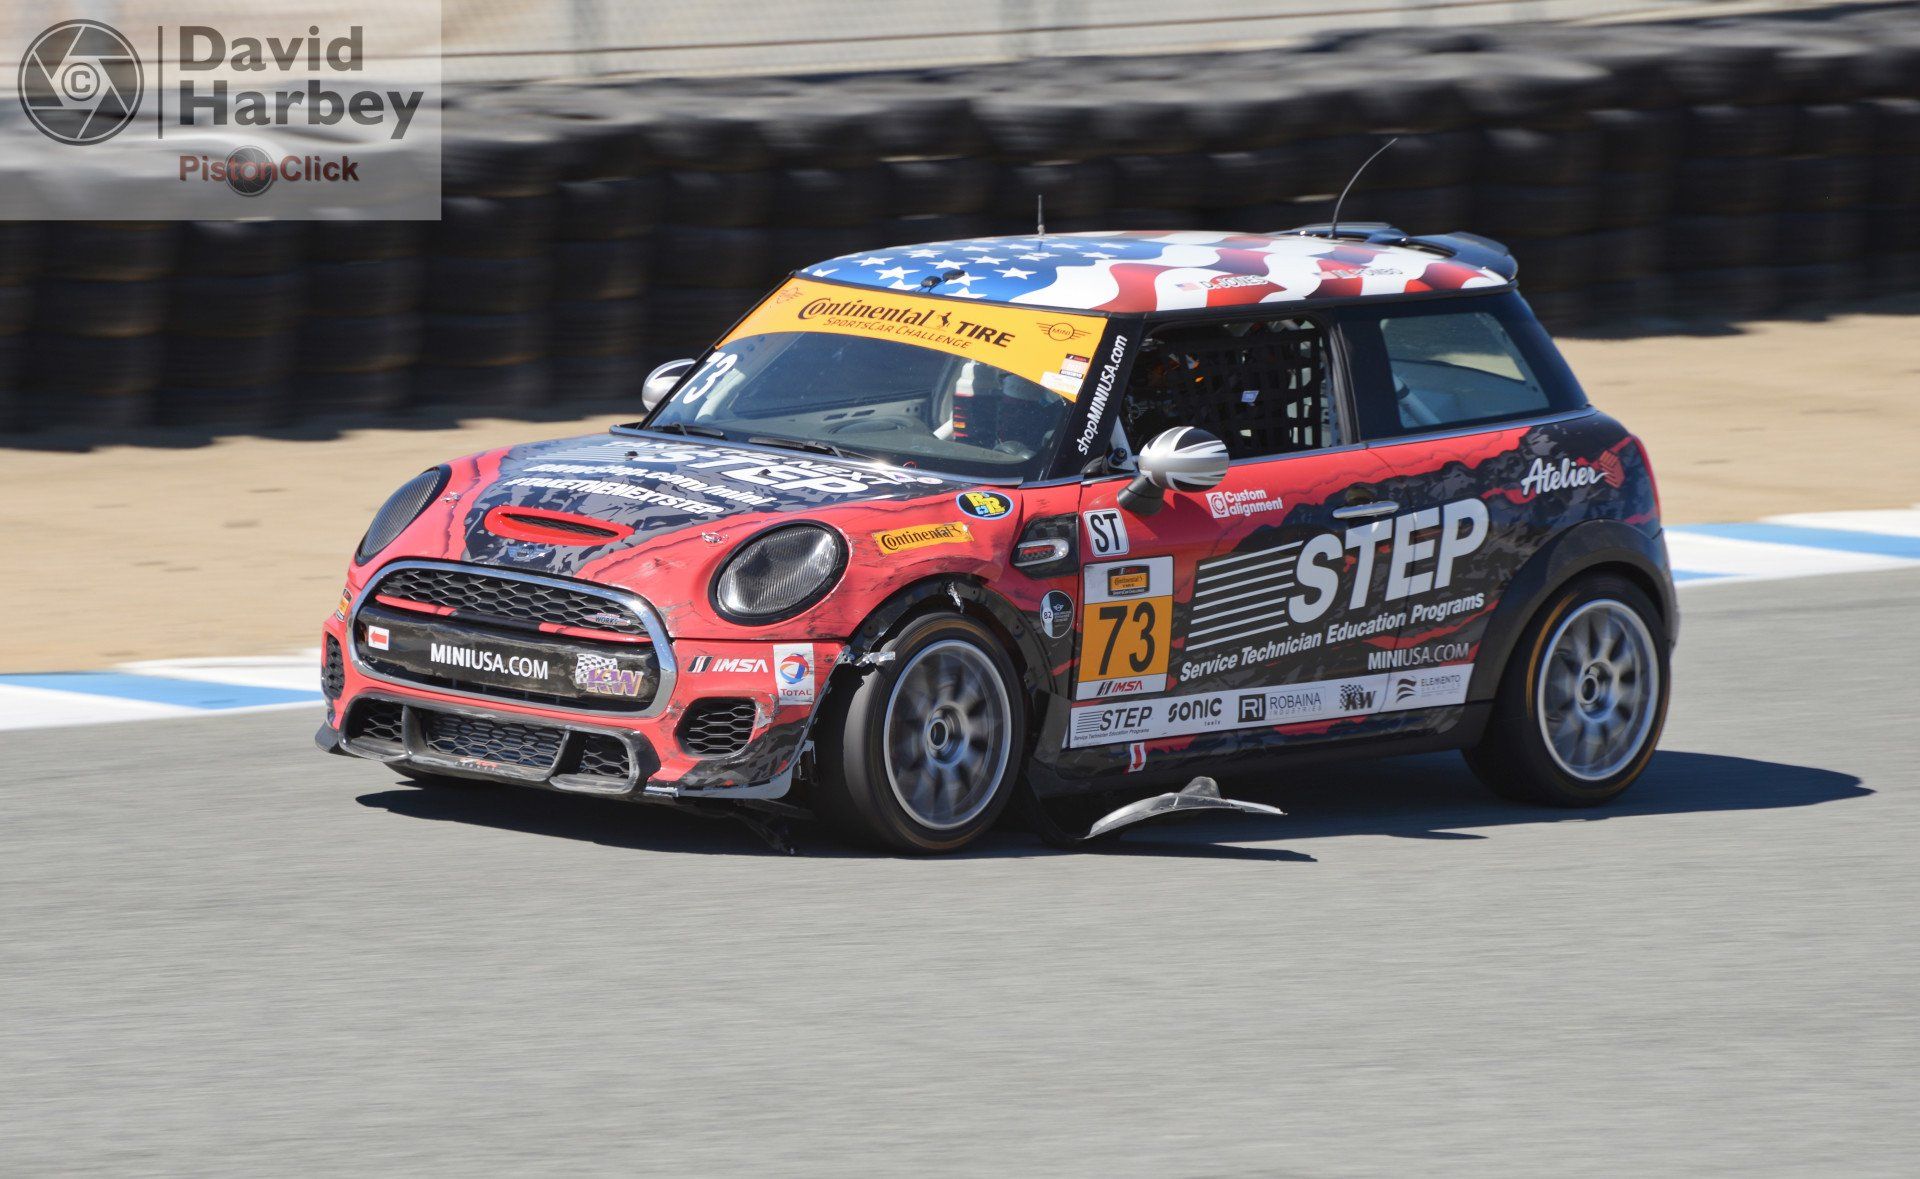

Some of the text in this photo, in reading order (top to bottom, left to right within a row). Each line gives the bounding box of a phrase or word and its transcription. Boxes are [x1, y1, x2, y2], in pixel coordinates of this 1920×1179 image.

[797, 297, 1016, 348] Continental TIRE
[1051, 327, 1071, 336] MINI
[894, 325, 972, 349] CHALLENGE
[670, 352, 738, 404] 73
[1077, 334, 1128, 456] shopMINIUSA.com
[632, 450, 869, 495] STEP
[1521, 458, 1609, 496] Atelier
[1225, 489, 1267, 504] Custom
[1229, 497, 1283, 517] alignment
[880, 526, 954, 551] Continental
[1089, 513, 1121, 553] ST
[1288, 497, 1490, 625] STEP
[1043, 611, 1052, 620] 82
[1098, 601, 1156, 676] 73
[1180, 590, 1485, 684] Service Technician Education Programs
[430, 643, 549, 680] MINIUSA.COM
[713, 657, 769, 674] IMSA
[1368, 642, 1469, 670] MINIUSA.COM
[780, 687, 813, 698] TOTAL
[1111, 681, 1143, 694] IMSA
[1421, 674, 1461, 688] ELEMENTO
[1269, 692, 1321, 710] ROBAINA
[1099, 706, 1153, 732] STEP
